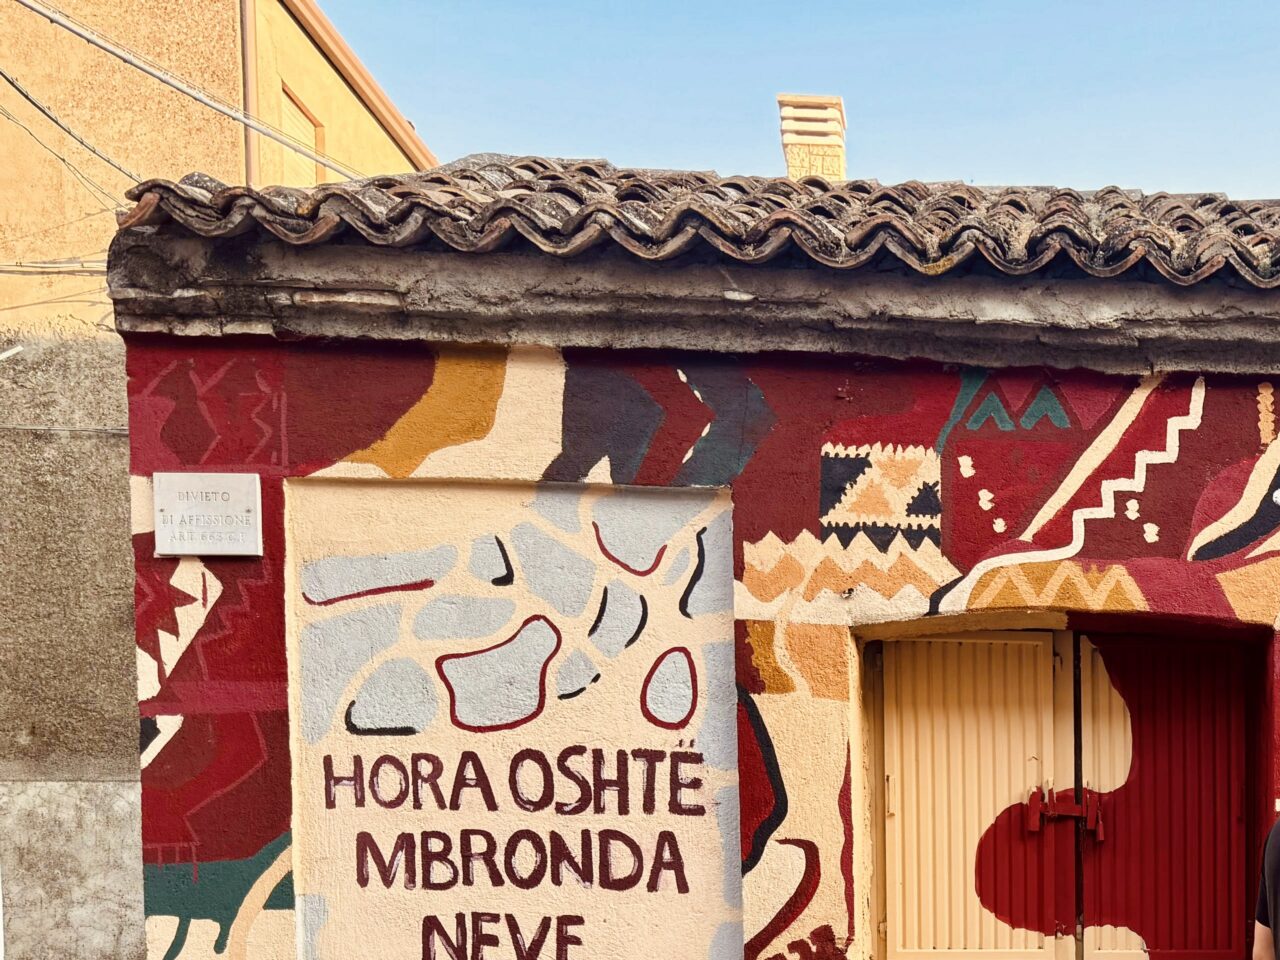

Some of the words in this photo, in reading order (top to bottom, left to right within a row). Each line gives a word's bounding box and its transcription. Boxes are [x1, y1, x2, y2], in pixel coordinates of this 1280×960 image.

[178, 491, 231, 502] DIVIETO
[162, 515, 174, 525] DI
[179, 514, 252, 526] AFFISSIONE
[322, 749, 499, 812] HORA
[508, 738, 706, 816] OSHTË
[355, 828, 690, 894] MBRONDA
